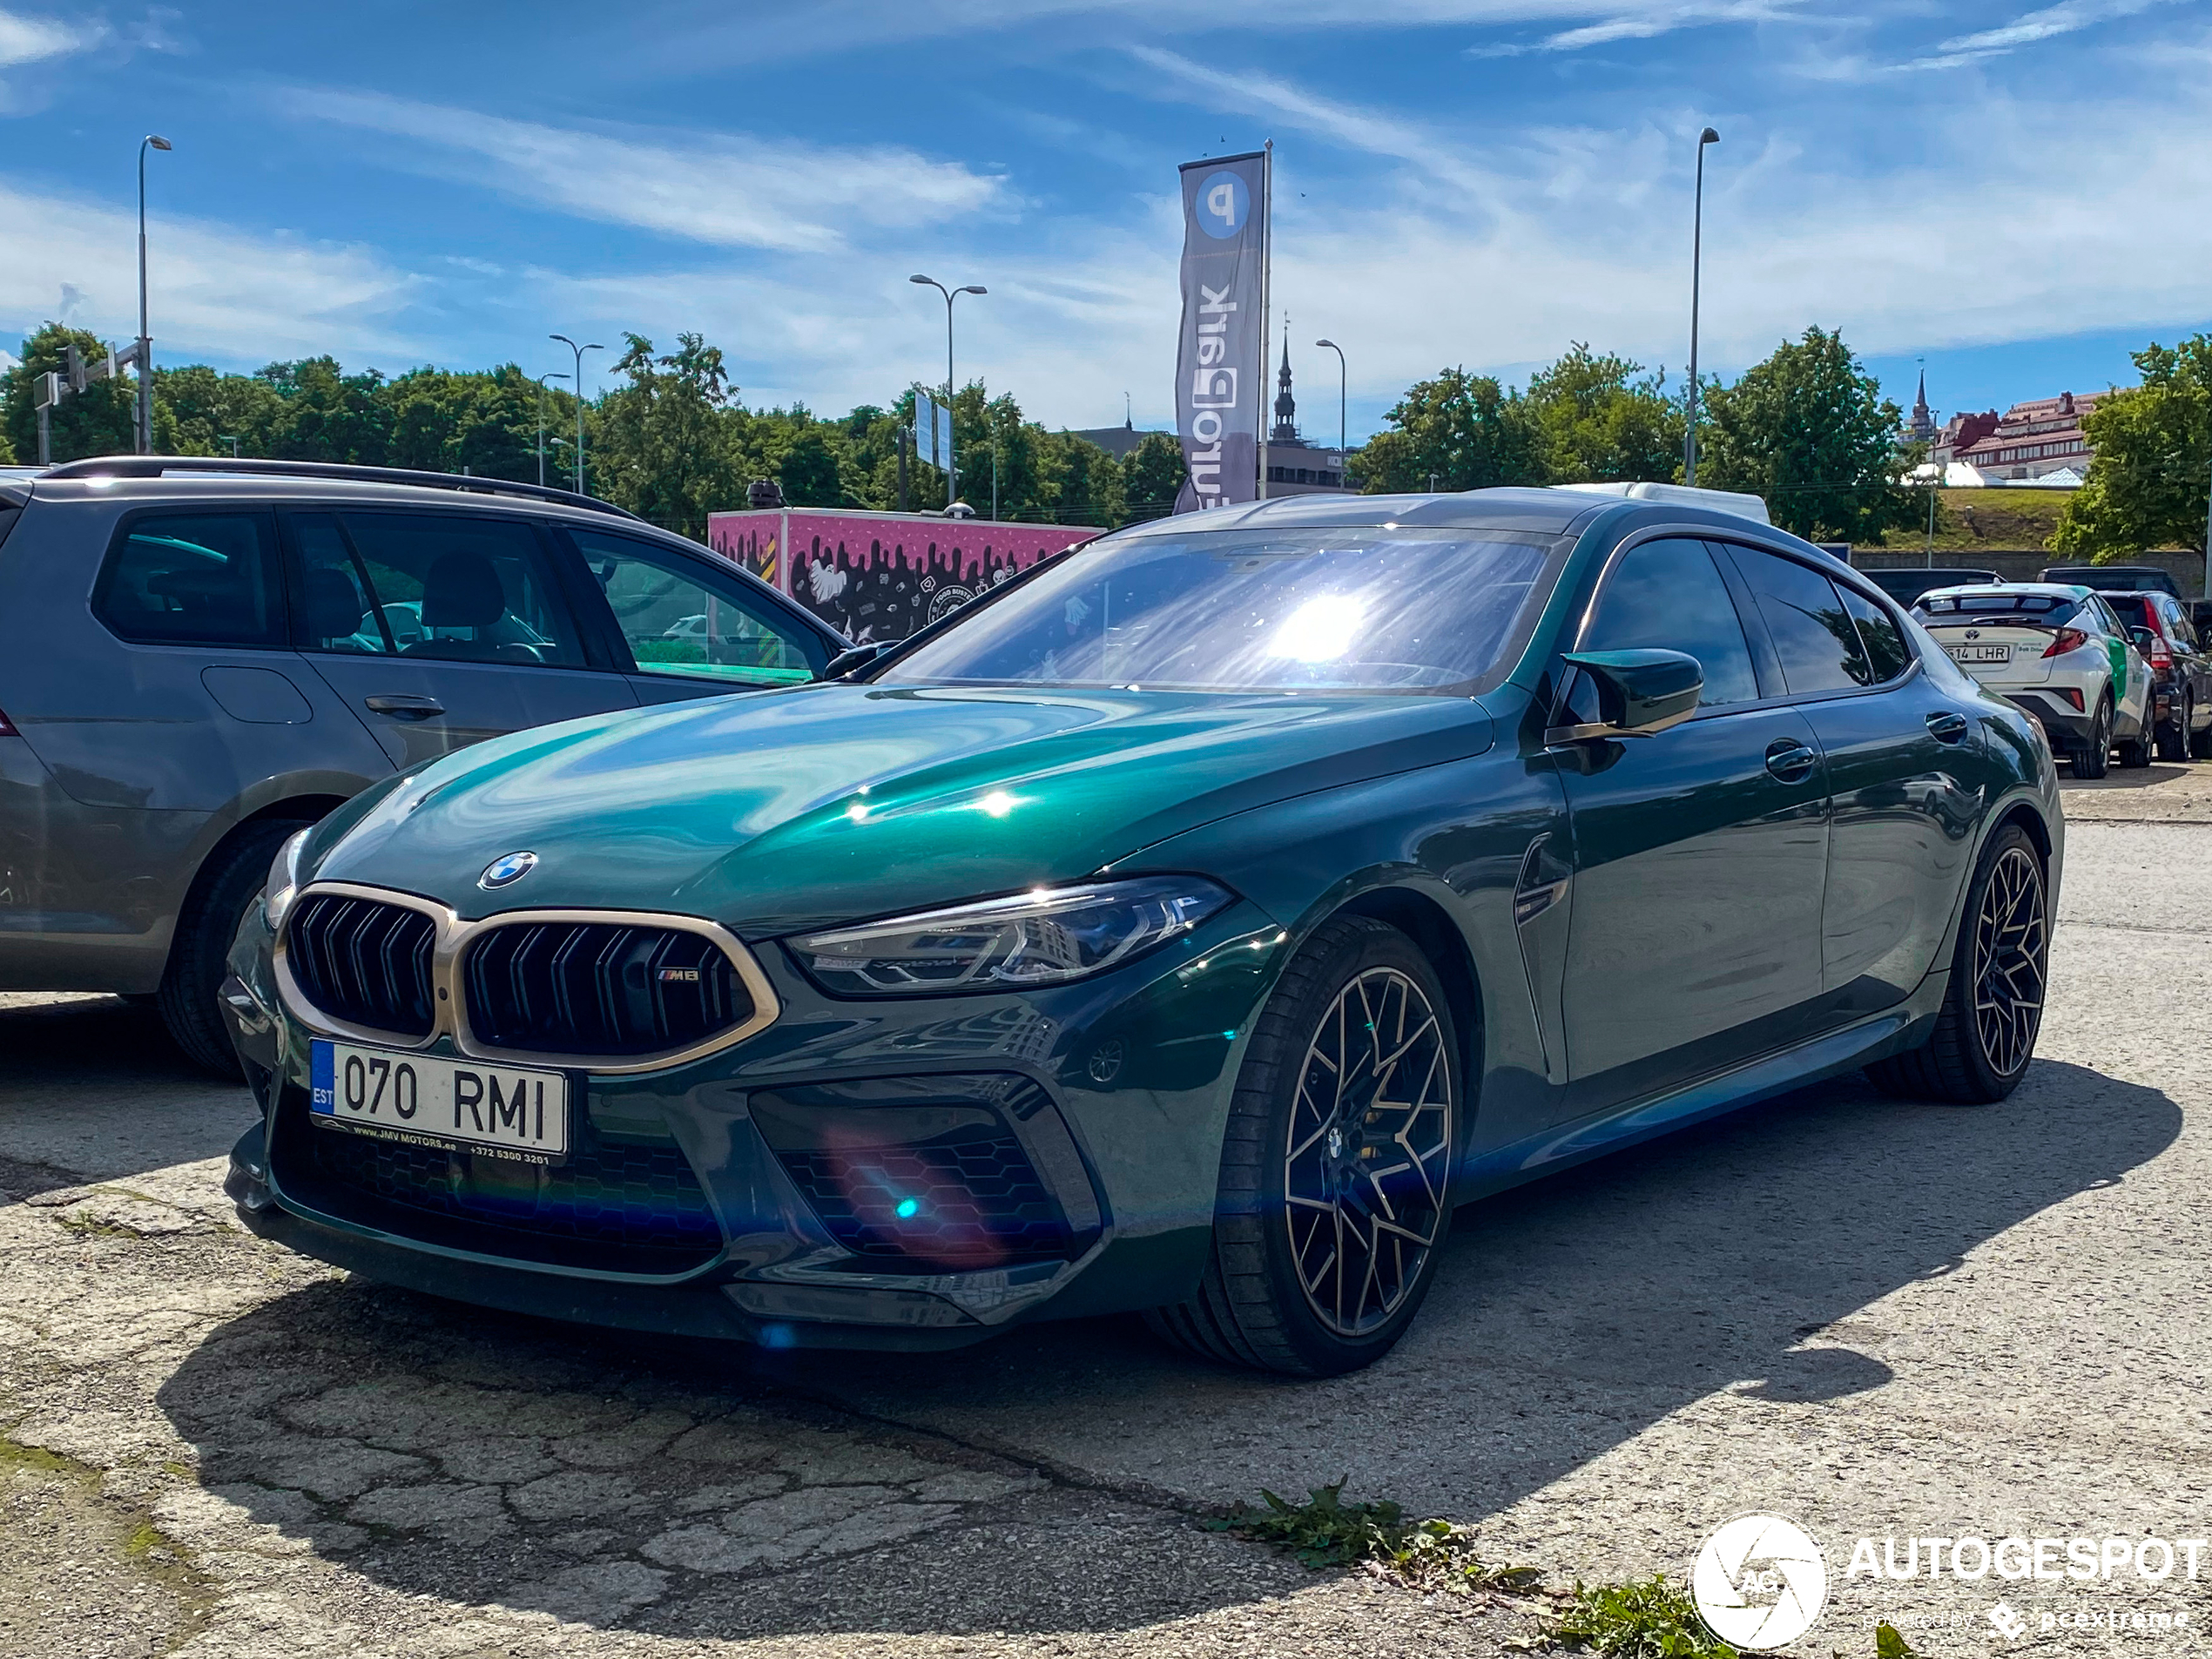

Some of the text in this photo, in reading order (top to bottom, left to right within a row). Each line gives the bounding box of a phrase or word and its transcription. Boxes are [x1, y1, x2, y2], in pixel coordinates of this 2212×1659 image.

[935, 590, 952, 604] FOOD
[1977, 648, 2005, 659] LHR
[314, 1088, 334, 1105] EST
[345, 1055, 544, 1140] 070 RMI
[470, 1145, 495, 1158] +372
[523, 1153, 550, 1165] 3201
